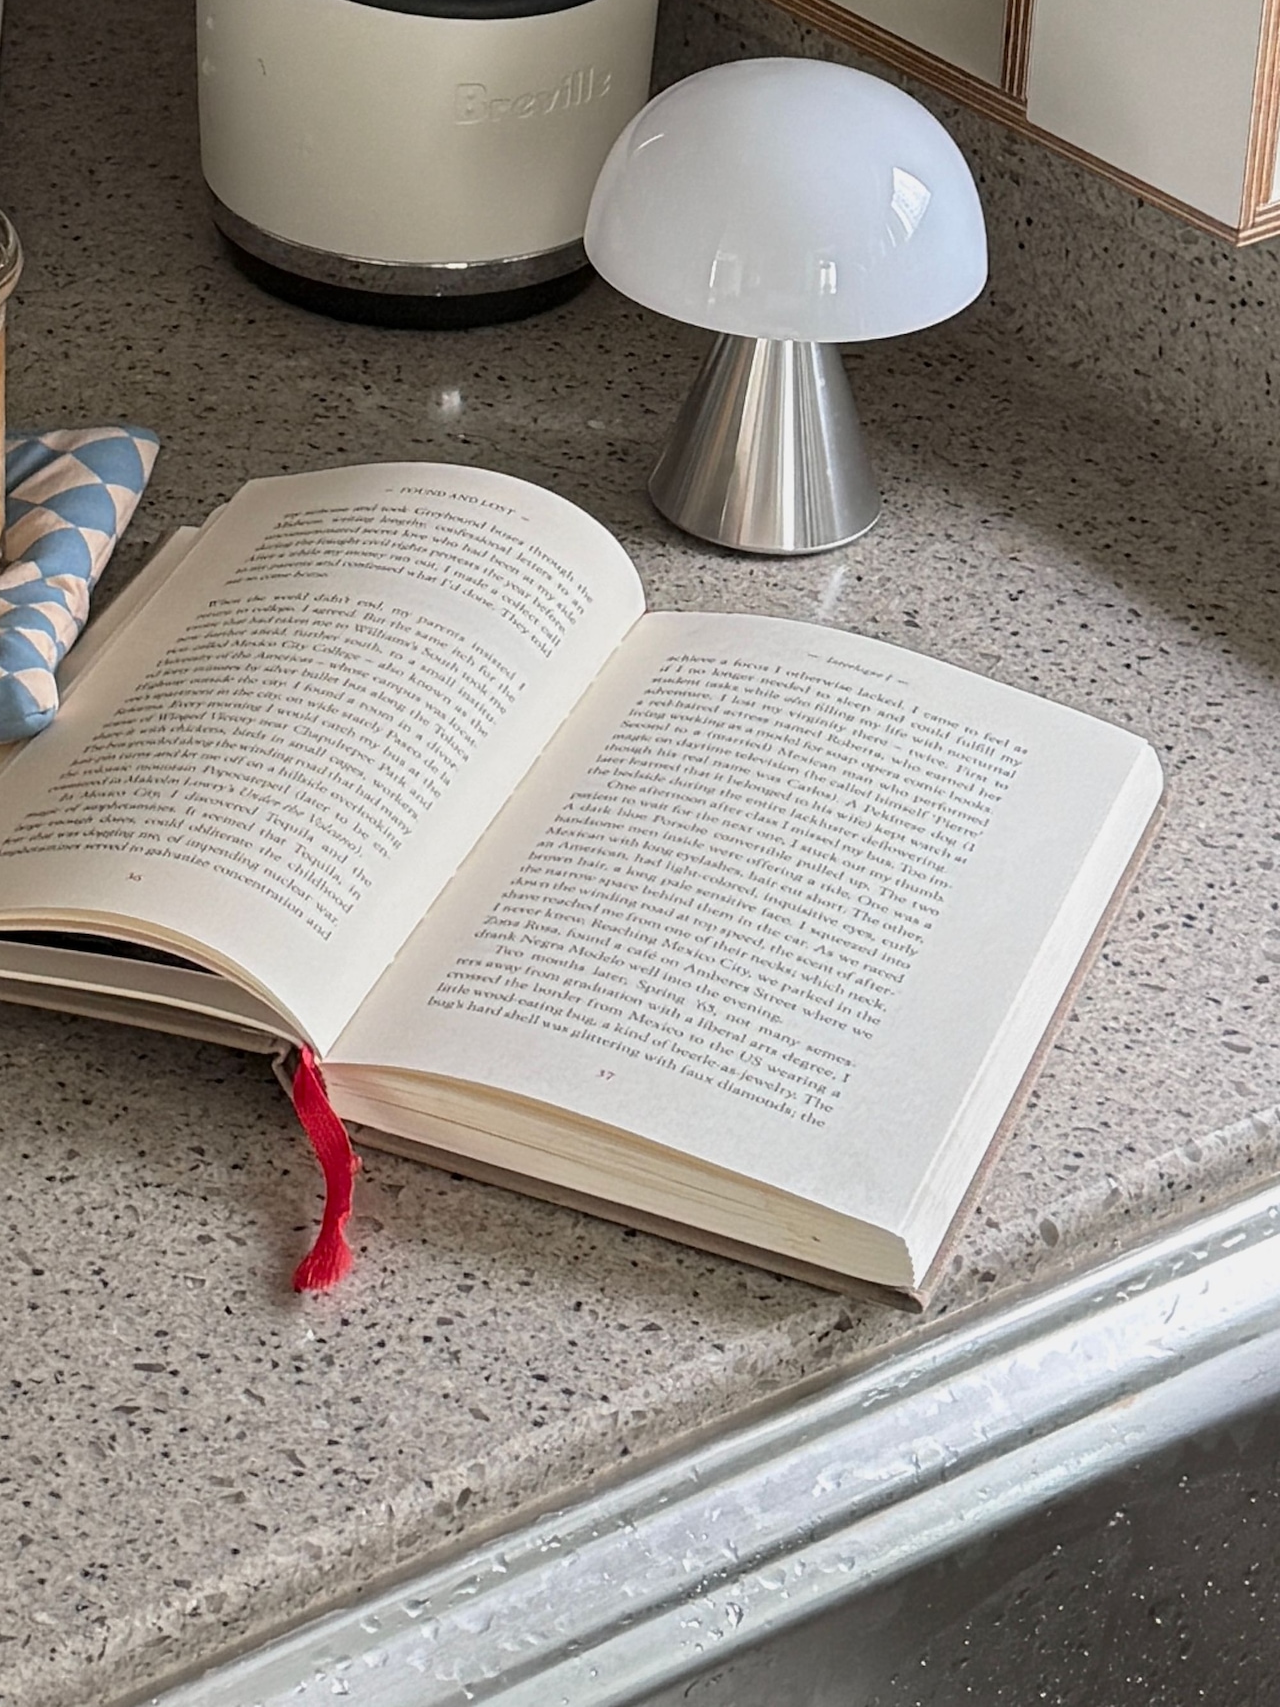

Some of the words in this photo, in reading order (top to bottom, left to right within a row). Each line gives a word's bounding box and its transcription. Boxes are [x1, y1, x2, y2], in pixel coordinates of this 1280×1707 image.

[455, 68, 611, 125] Breville
[449, 493, 478, 504] AND
[480, 499, 516, 516] LOST
[595, 1069, 616, 1081] 37
